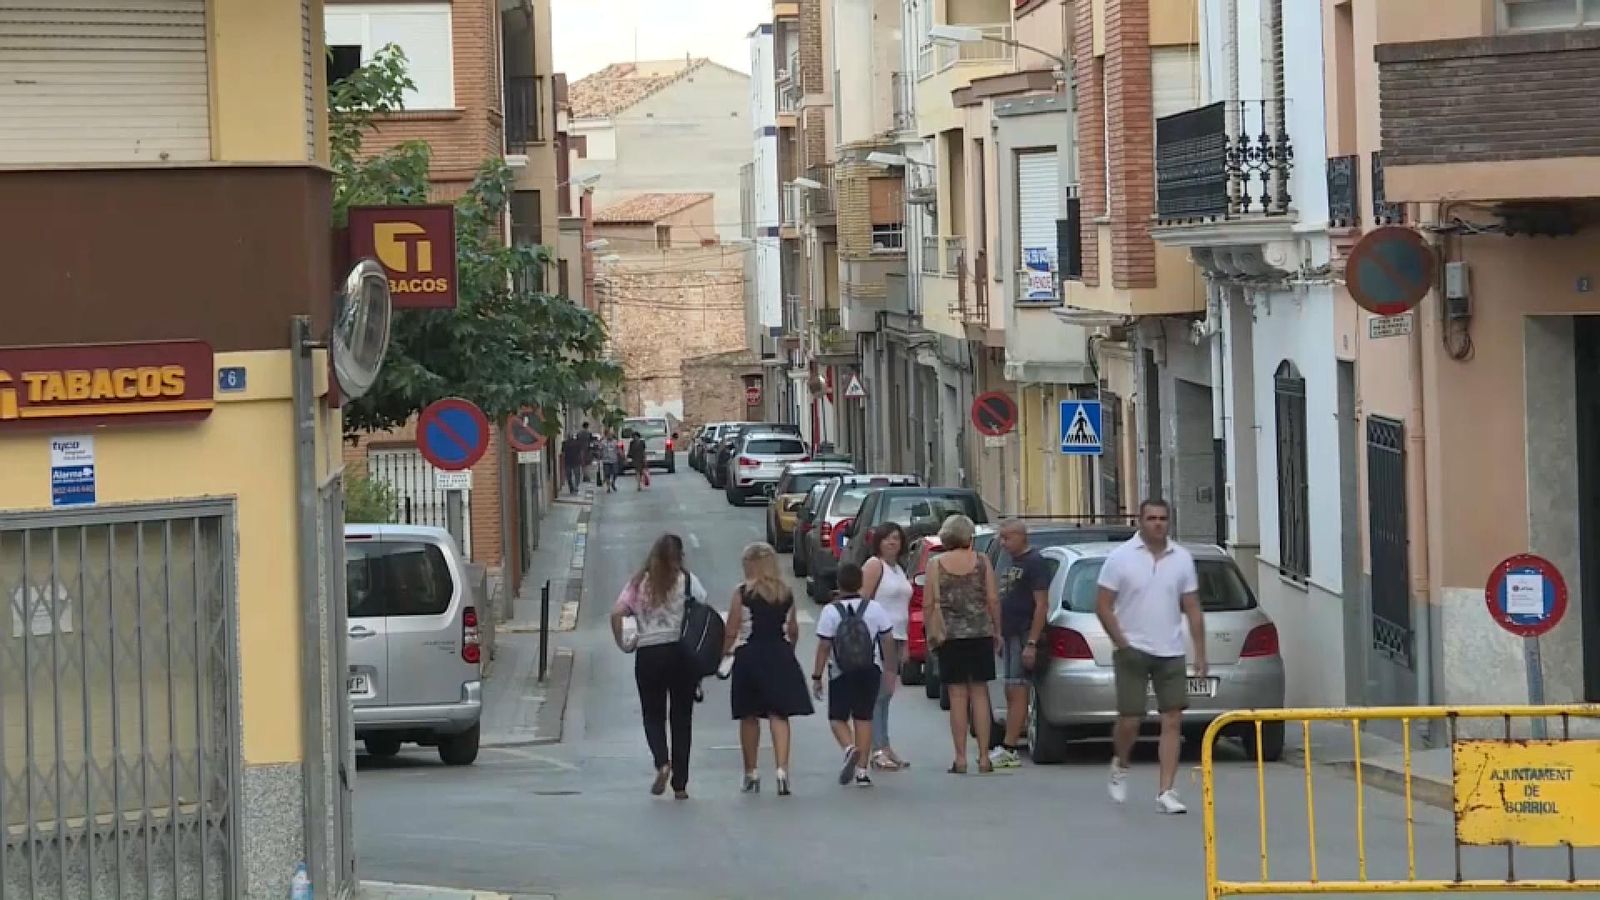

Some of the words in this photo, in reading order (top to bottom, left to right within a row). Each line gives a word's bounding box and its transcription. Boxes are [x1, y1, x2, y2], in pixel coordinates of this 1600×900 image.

[388, 277, 448, 294] BACOS
[20, 364, 186, 401] TABACOS
[228, 371, 237, 386] 6
[52, 441, 80, 452] tyco
[53, 469, 83, 479] Alarma
[1490, 768, 1574, 781] AJUNTAMENT
[1524, 785, 1540, 797] DE
[1505, 799, 1560, 814] BORRIOL
